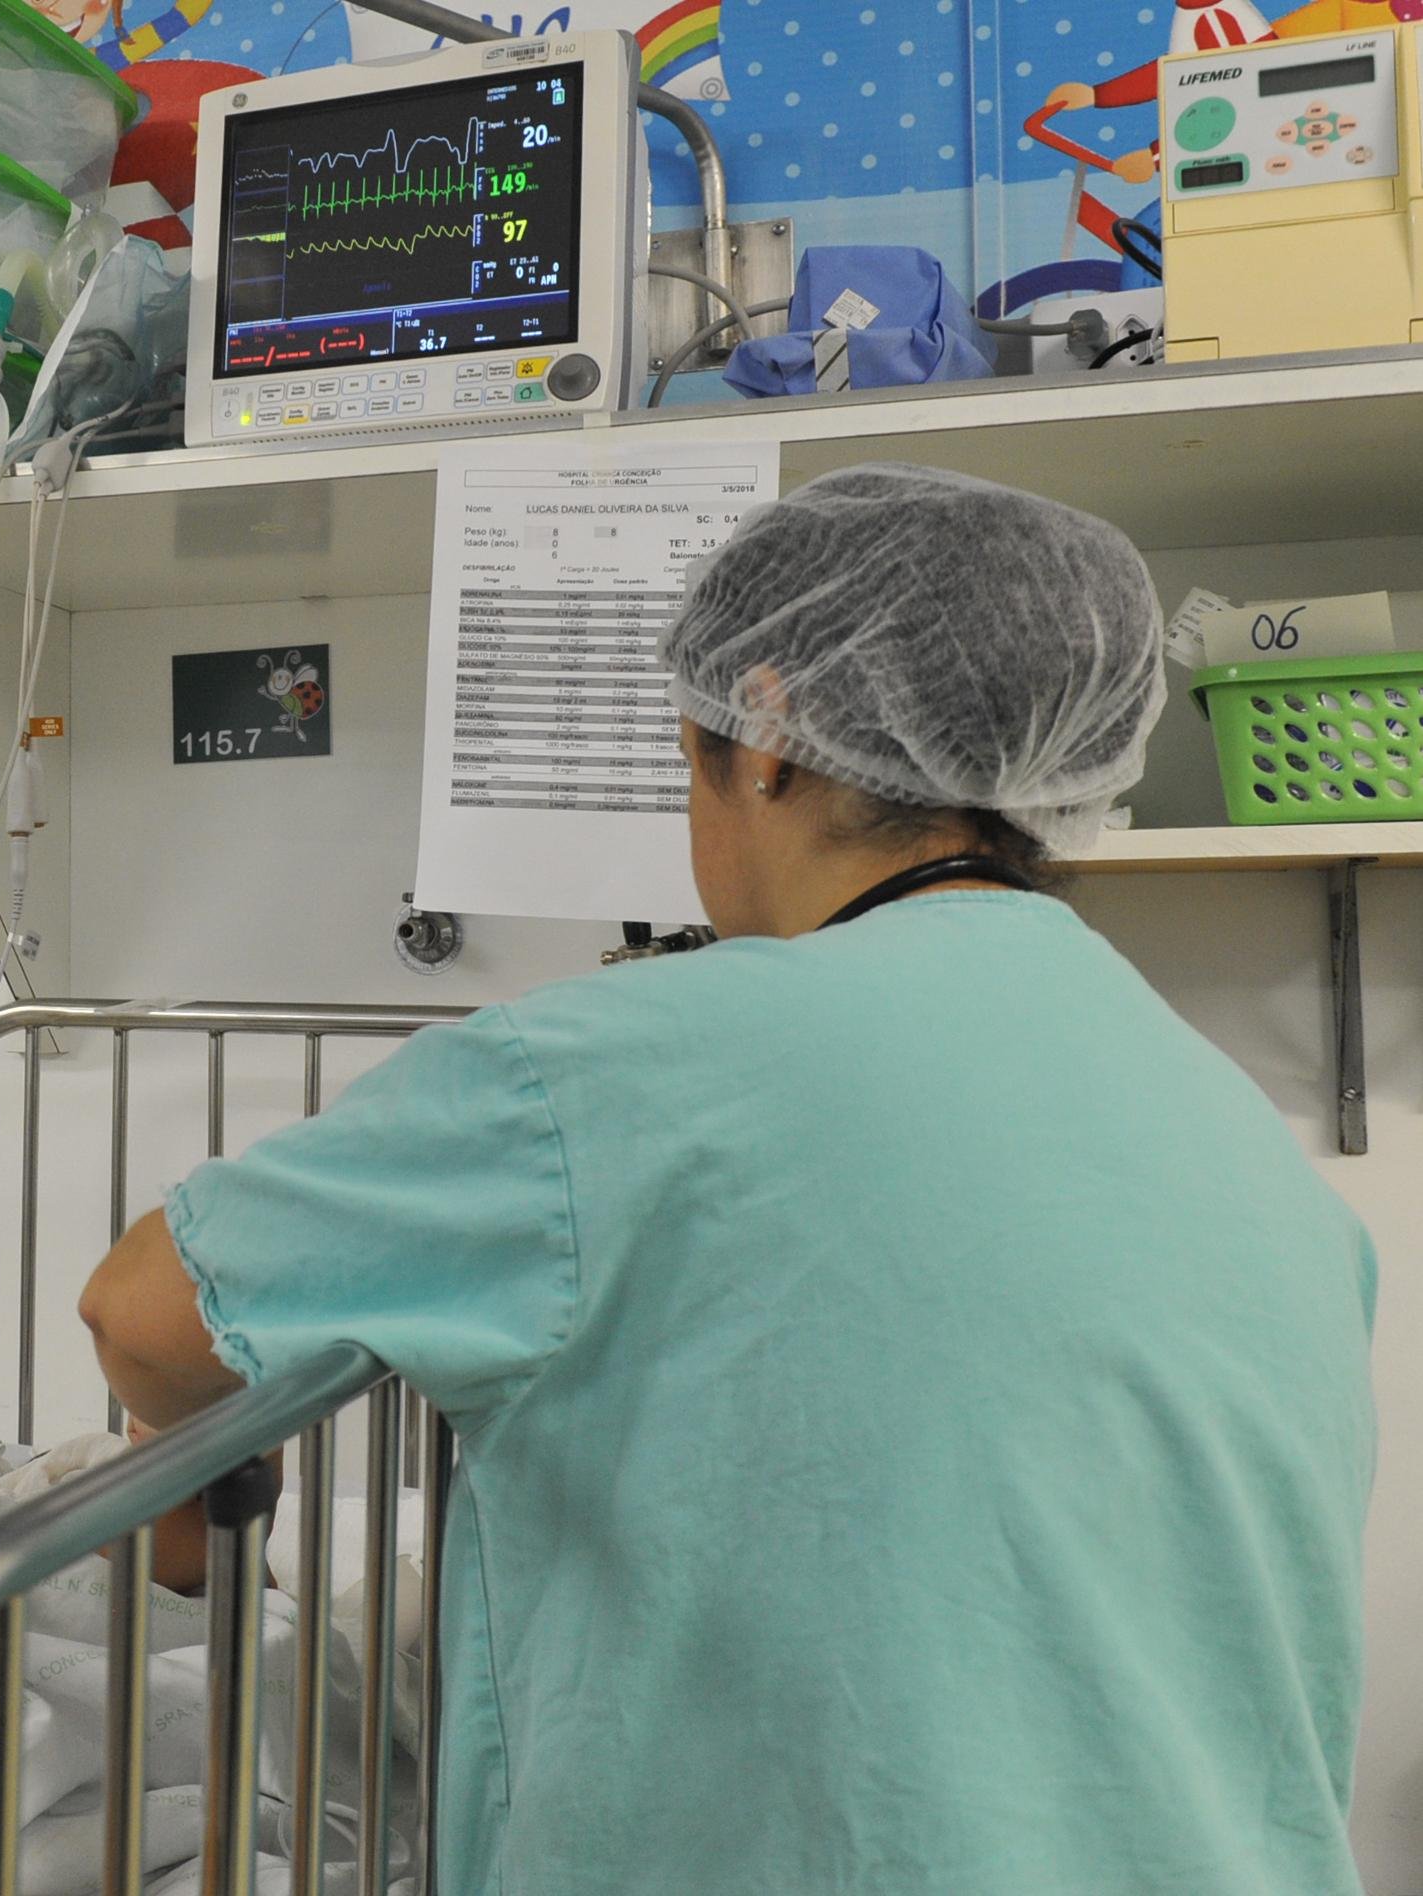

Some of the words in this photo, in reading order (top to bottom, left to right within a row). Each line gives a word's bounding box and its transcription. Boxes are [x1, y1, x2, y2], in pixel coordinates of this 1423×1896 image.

[1358, 41, 1376, 50] LINE
[1179, 67, 1243, 86] LIFEMED
[523, 124, 548, 148] 20
[490, 171, 527, 197] 149
[503, 219, 527, 243] 97
[419, 337, 447, 351] 36.7
[526, 505, 559, 514] LUCAS
[561, 505, 596, 514] DANIEL
[598, 504, 643, 514] OLIVEIRA
[645, 504, 659, 513] DA
[661, 503, 689, 513] SILVA
[696, 515, 713, 524] SC:
[464, 526, 487, 536] Peso
[701, 539, 716, 548] 3,5
[1251, 605, 1307, 651] 06
[181, 728, 262, 757] 115.7
